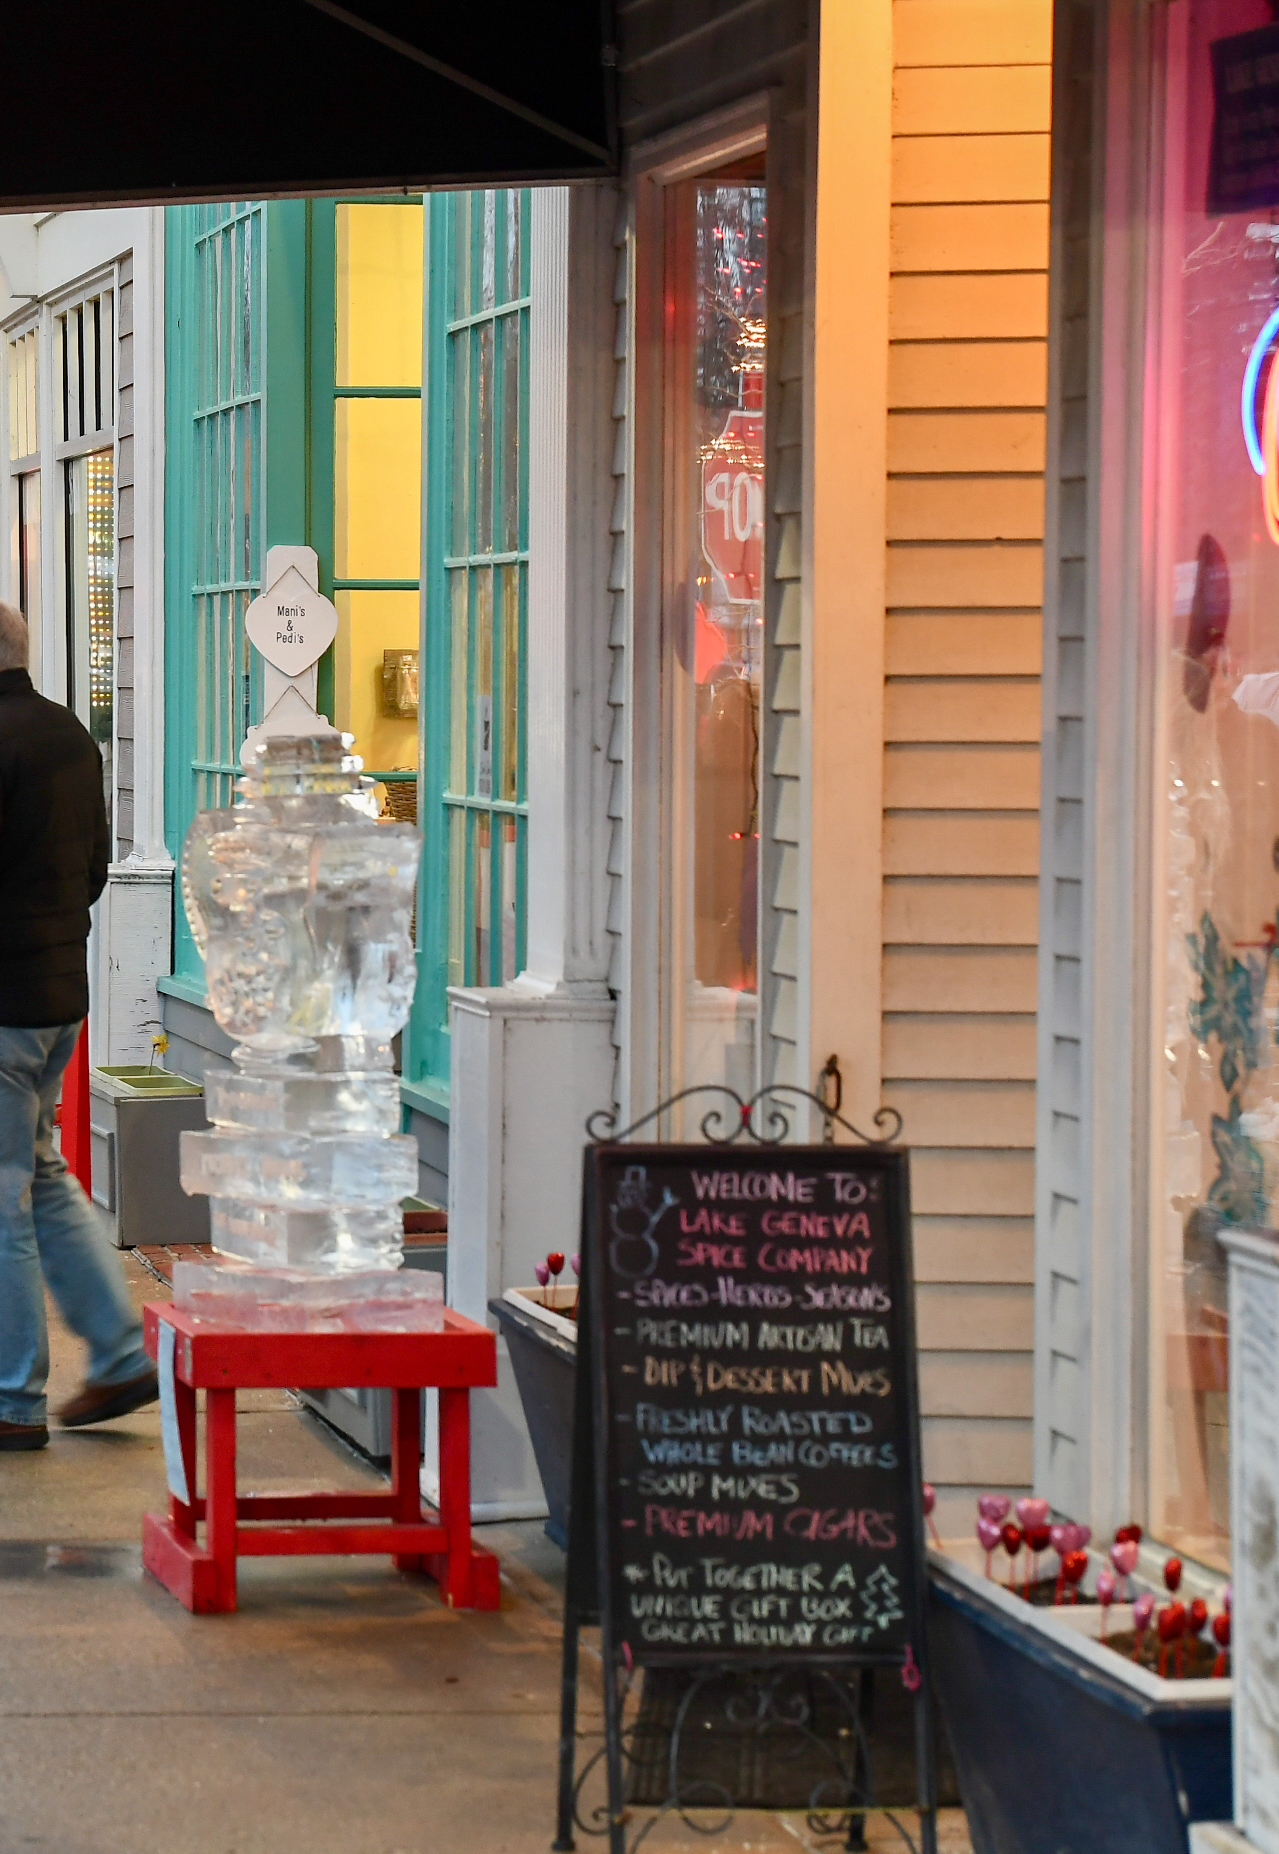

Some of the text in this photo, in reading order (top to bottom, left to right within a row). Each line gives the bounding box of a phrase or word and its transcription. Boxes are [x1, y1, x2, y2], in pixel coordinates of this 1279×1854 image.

[277, 604, 306, 617] Mani's
[286, 619, 294, 632] &
[276, 631, 304, 644] Pedi's
[691, 1170, 818, 1203] WELCOME
[680, 1208, 870, 1239] LAKE GENEVA
[677, 1240, 873, 1275] SPICE COMPANY
[636, 1318, 749, 1351] PREMIUM
[848, 1317, 890, 1350] TEA
[644, 1355, 686, 1387] DIP
[706, 1362, 812, 1395] DESSERT
[637, 1402, 873, 1436] FRESHLY ROASTED
[641, 1438, 722, 1466] WHOLE
[638, 1468, 800, 1504] SOUP MIXES
[645, 1503, 897, 1549] PREMIUM CIGARS
[652, 1551, 857, 1592] PUT TOGETHER A
[730, 1594, 792, 1620] GIFT
[801, 1596, 853, 1620] BOX
[641, 1618, 726, 1644] GREAT
